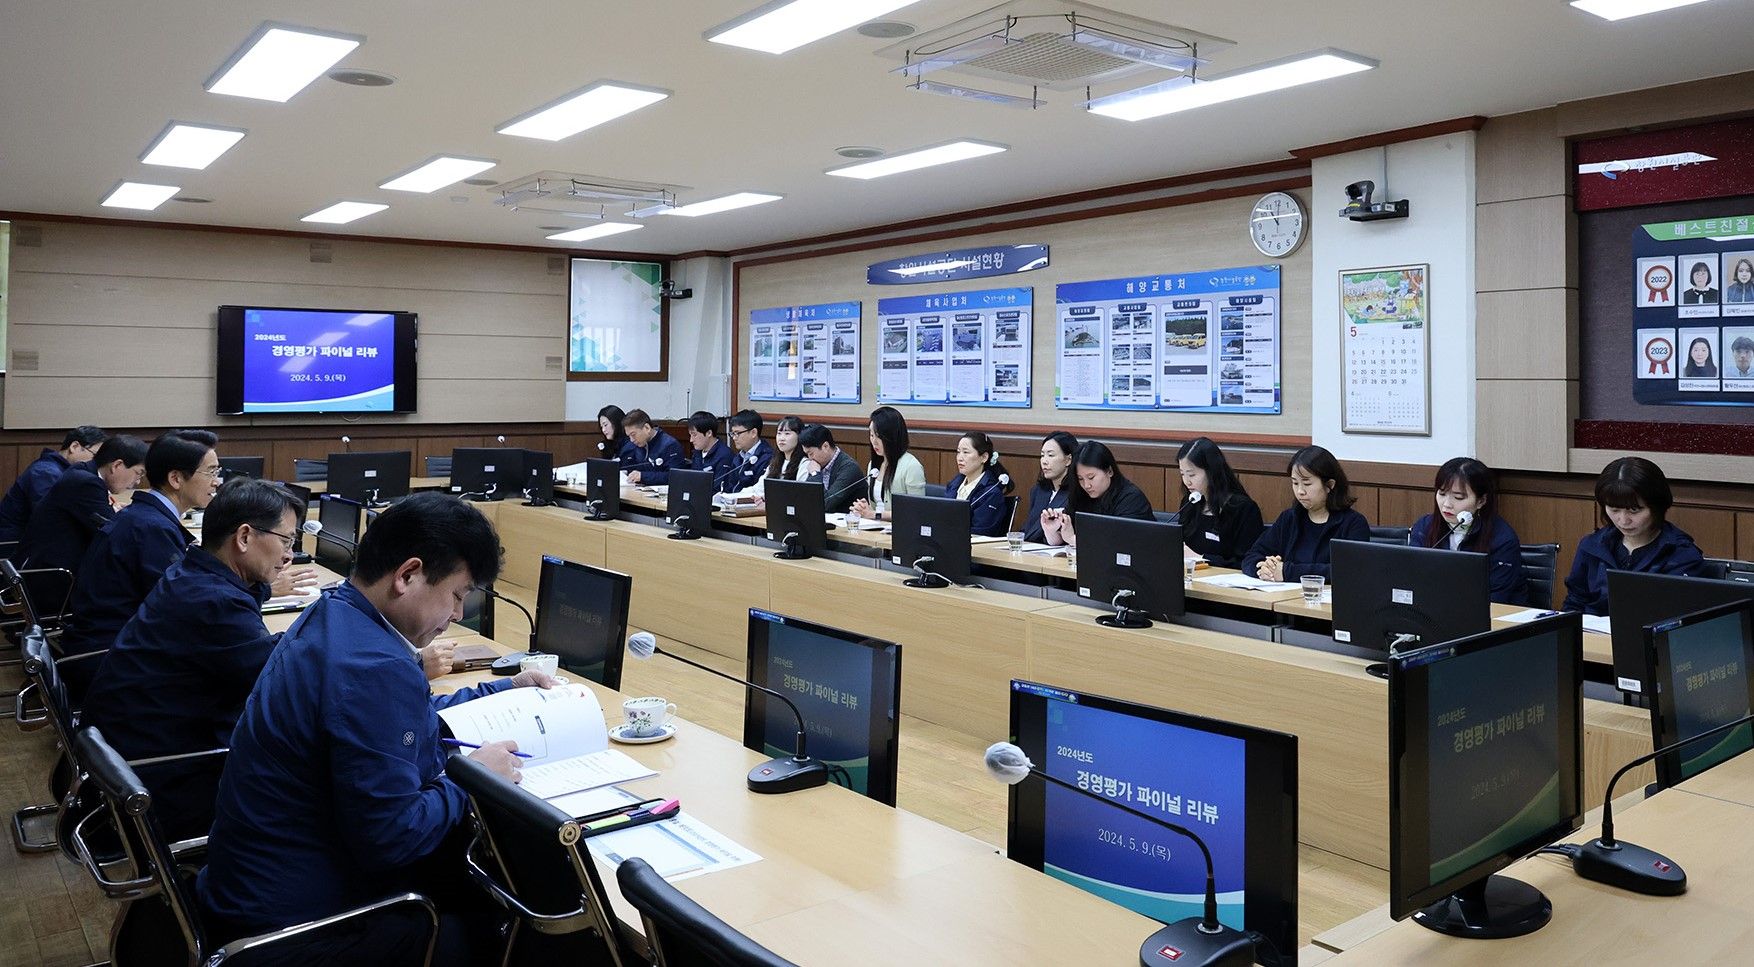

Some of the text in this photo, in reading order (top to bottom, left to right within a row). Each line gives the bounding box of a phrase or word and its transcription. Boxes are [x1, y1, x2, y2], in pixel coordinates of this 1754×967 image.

[1674, 218, 1754, 236] 베스트친절
[961, 252, 1004, 272] 시설현황
[254, 334, 287, 342] 2024년도
[1350, 326, 1357, 337] 5
[272, 345, 378, 358] 경영평가 파이널 리뷰
[1651, 347, 1668, 355] 2023
[290, 374, 313, 383] 2024.
[315, 374, 323, 383] 5.
[783, 674, 858, 710] 경영평가 파이널 리뷰
[1453, 703, 1545, 753] 경영평가 파이널 리뷰
[1057, 745, 1094, 764] 2024년도
[1076, 769, 1219, 825] 경영평가 파이널 리뷰
[1098, 828, 1171, 863] 2024. 5. 9.(목)
